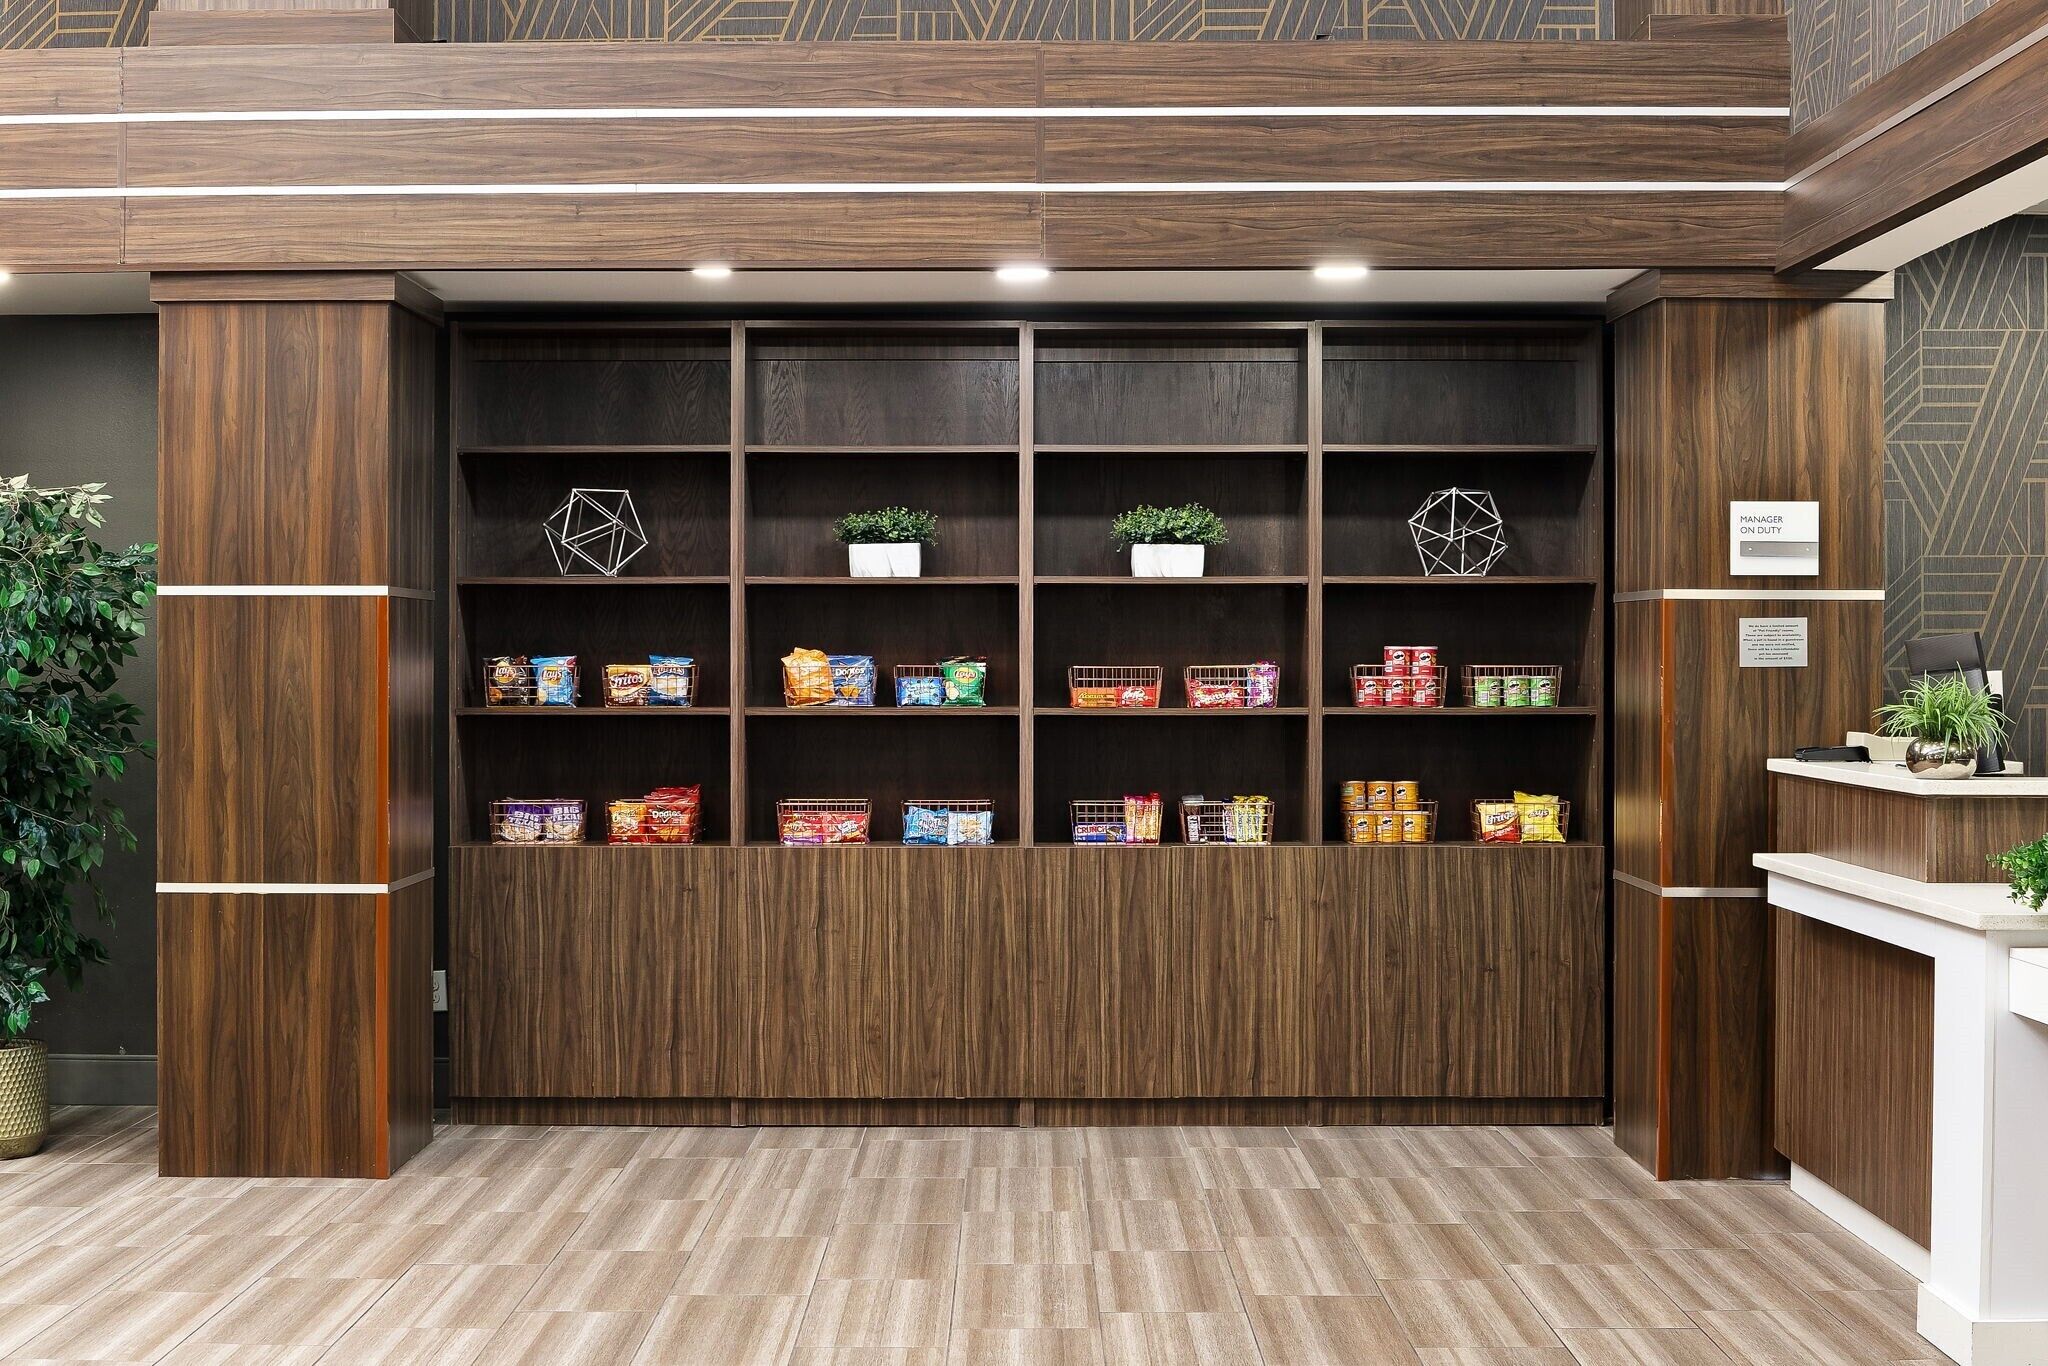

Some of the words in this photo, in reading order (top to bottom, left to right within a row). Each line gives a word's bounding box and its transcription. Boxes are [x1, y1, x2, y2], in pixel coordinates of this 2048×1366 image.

[1740, 515, 1783, 523] MANAGER
[1740, 526, 1755, 534] ON
[1757, 526, 1782, 534] DUTY
[552, 806, 580, 815] BIG
[513, 811, 540, 822] BIG
[508, 816, 541, 830] TEXAS
